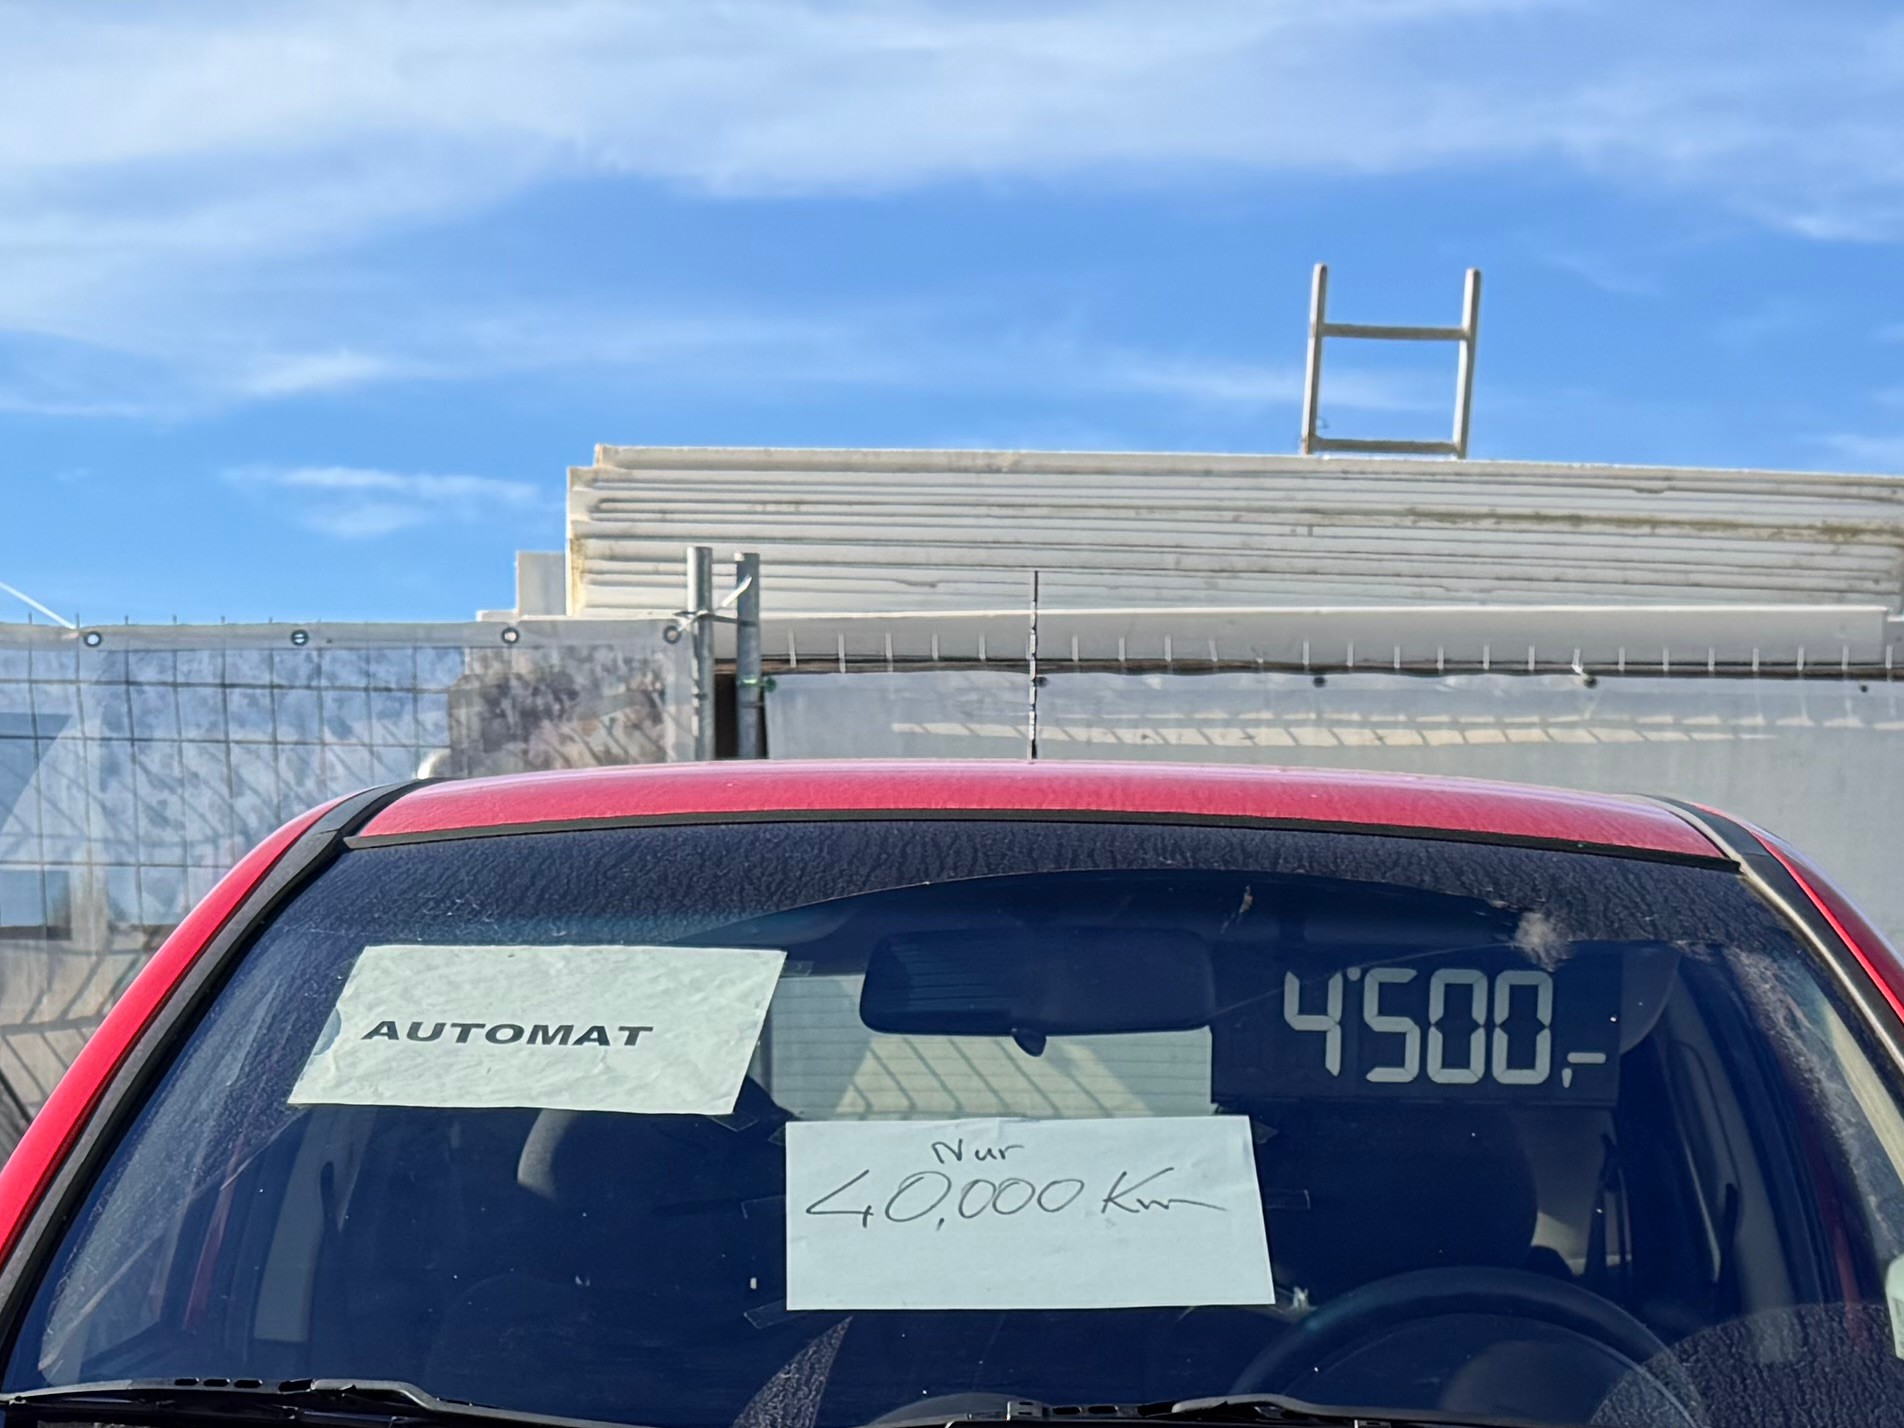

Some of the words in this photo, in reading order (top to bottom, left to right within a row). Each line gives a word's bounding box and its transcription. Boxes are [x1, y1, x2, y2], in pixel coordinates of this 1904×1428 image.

[360, 1020, 654, 1047] AUTOMAT
[932, 1138, 1025, 1164] Nur
[806, 1170, 1085, 1231] 40,000
[1101, 1167, 1227, 1214] Km
